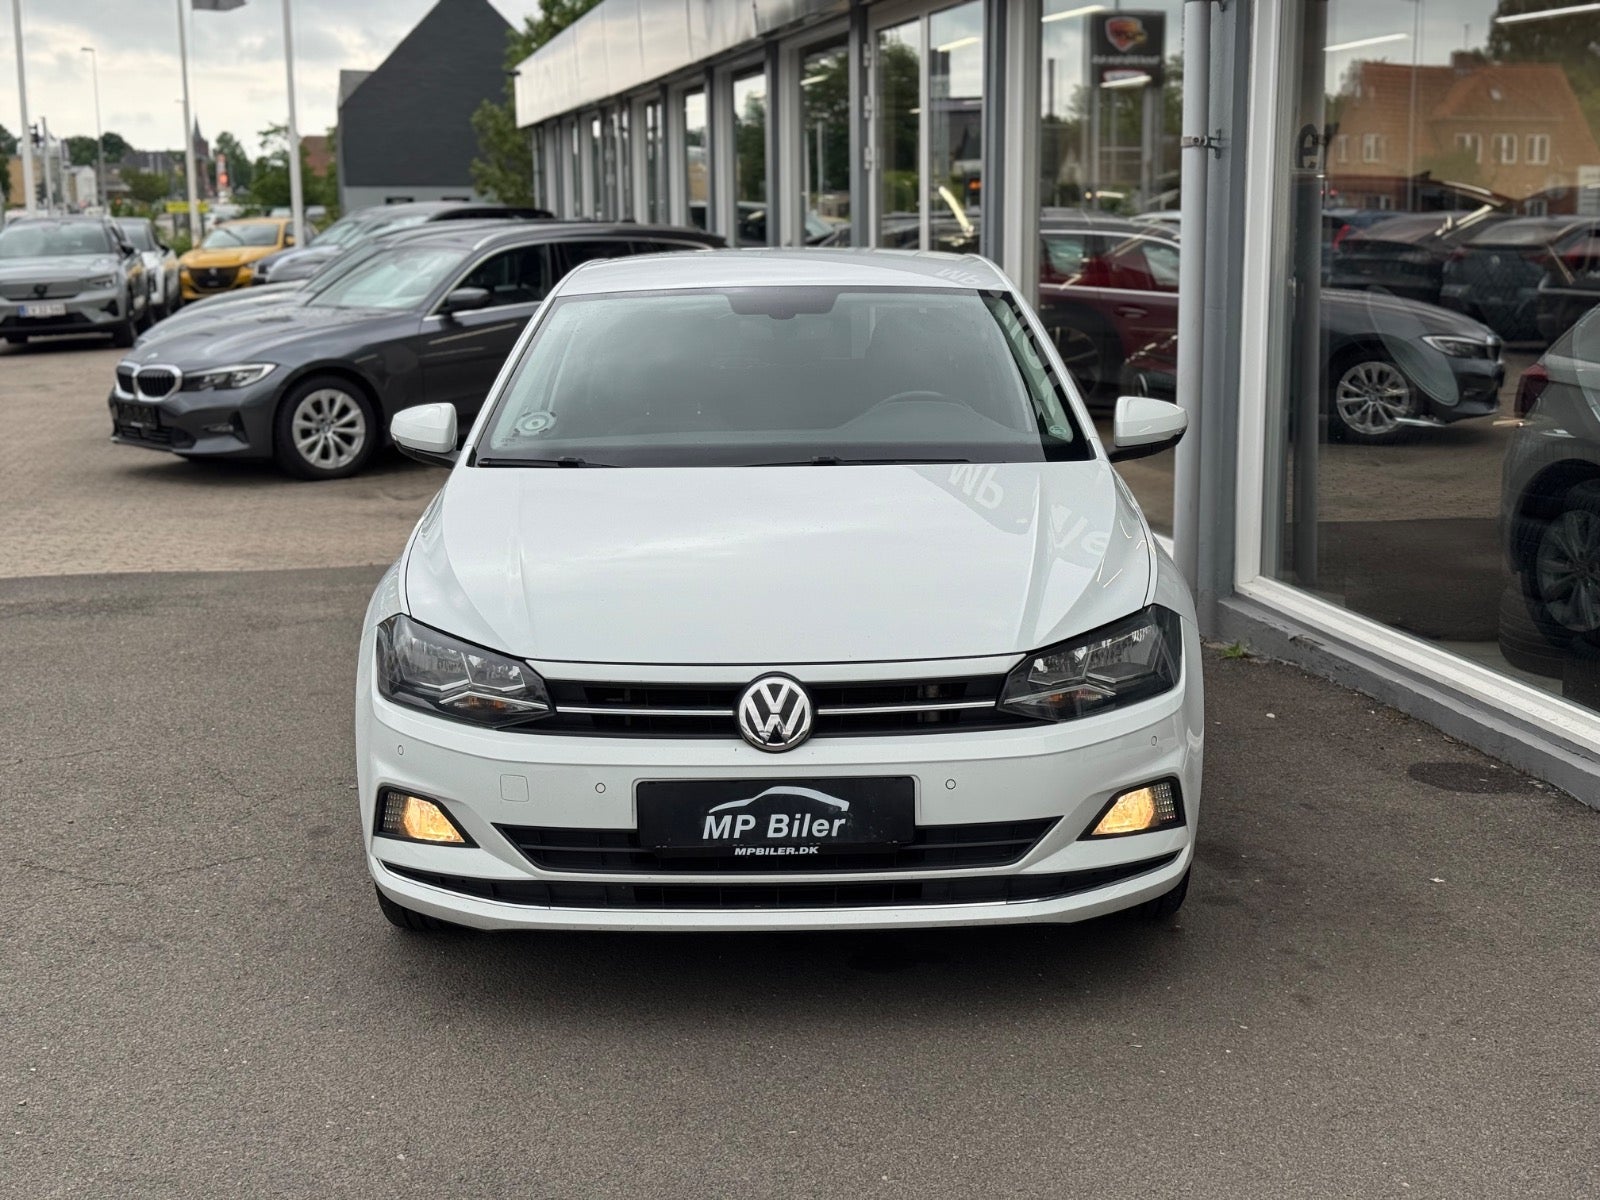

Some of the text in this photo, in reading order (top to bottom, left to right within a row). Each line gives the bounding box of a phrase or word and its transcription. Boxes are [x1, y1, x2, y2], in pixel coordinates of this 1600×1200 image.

[738, 675, 812, 748] VW
[702, 813, 847, 839] MP Biler
[734, 846, 819, 856] MPBILER.DK
